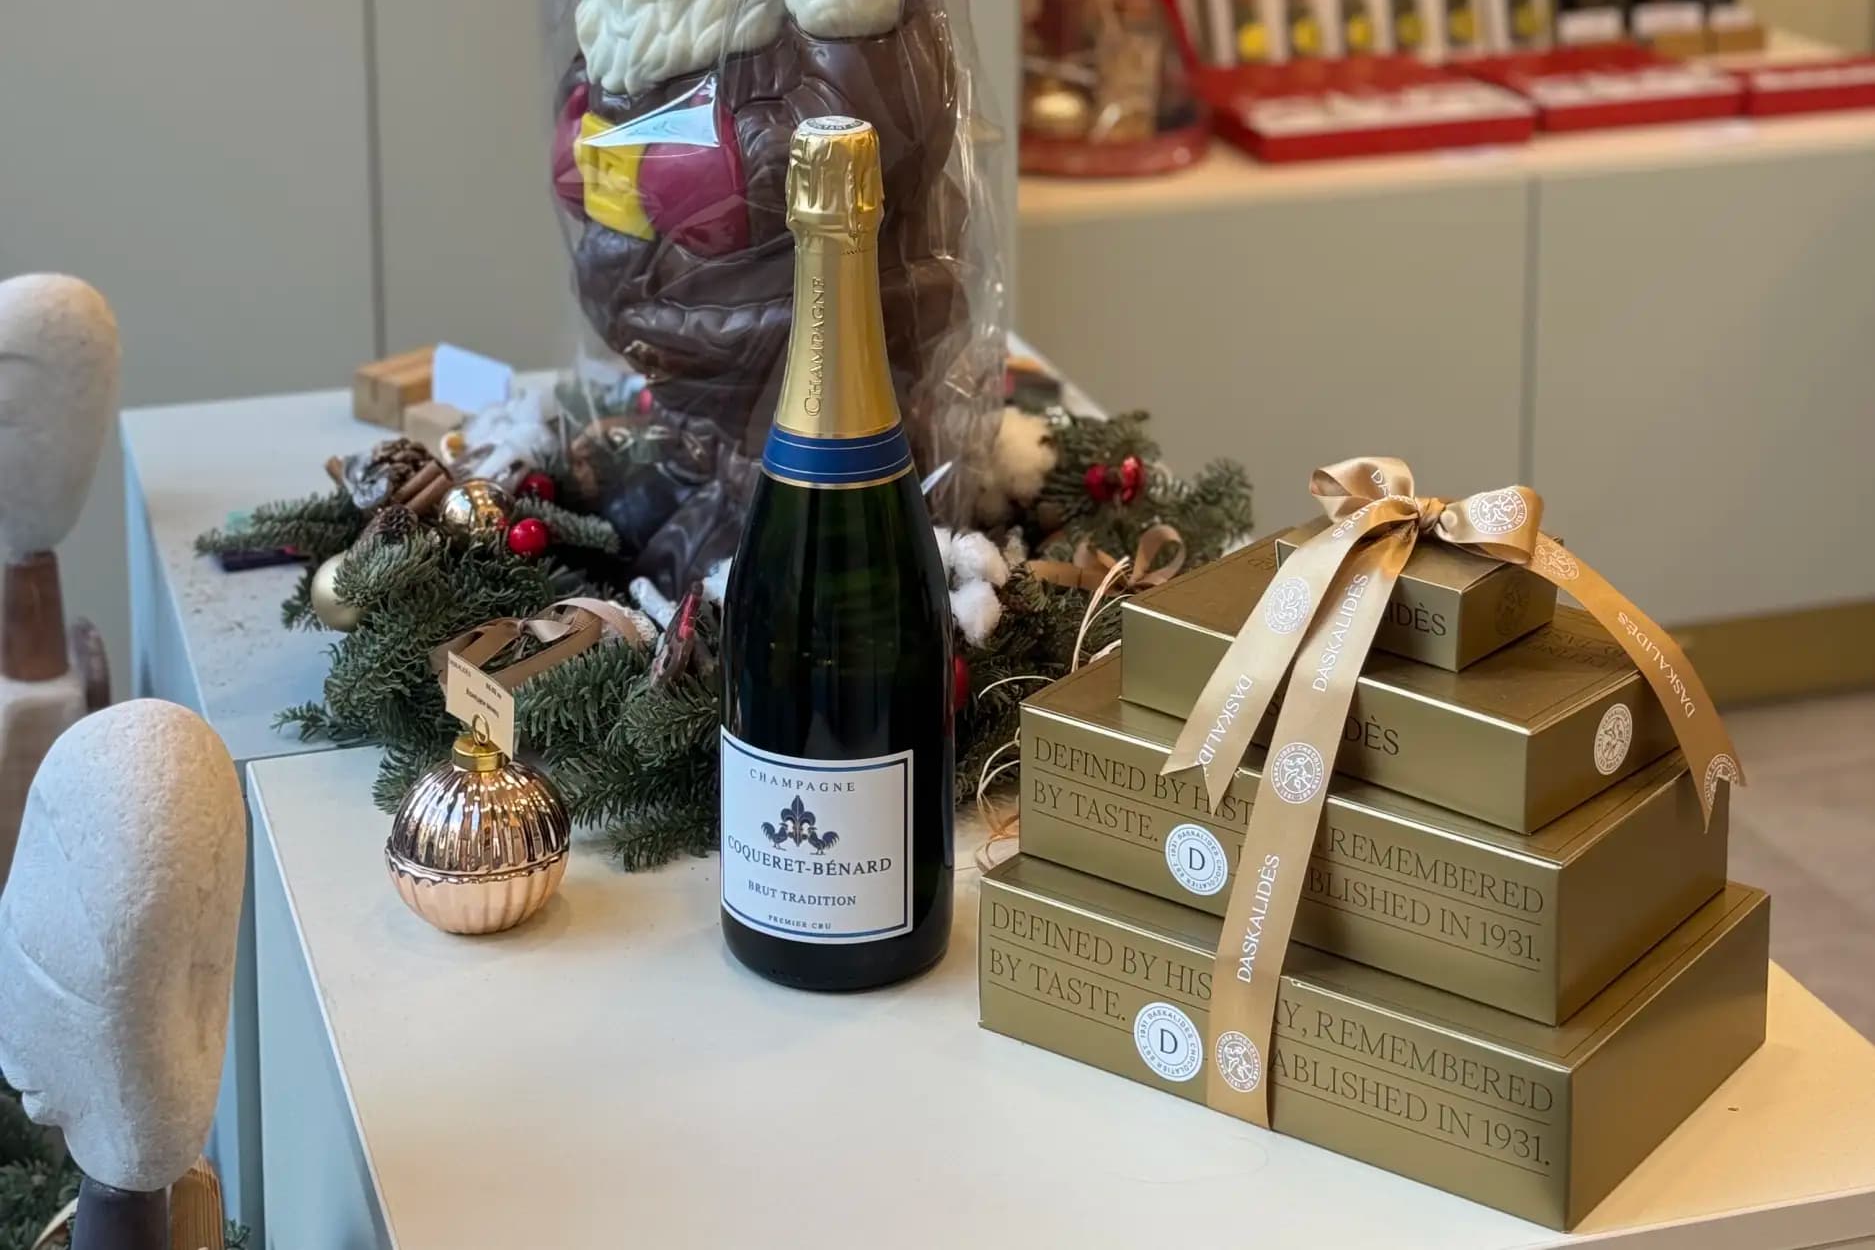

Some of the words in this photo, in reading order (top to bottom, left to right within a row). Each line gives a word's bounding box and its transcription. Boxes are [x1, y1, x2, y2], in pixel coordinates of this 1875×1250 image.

[804, 276, 825, 417] CHAMPAGNE
[1199, 674, 1253, 768] DASKALID
[749, 767, 856, 793] CHAMPAGNE
[1034, 737, 1146, 793] DEFINED
[1153, 774, 1186, 804] BY
[1328, 827, 1544, 914] REMEMBERED
[727, 834, 892, 877] COQUERET-BÉNARD
[748, 879, 778, 900] BRUT
[780, 890, 857, 907] TRADITION
[1033, 779, 1063, 810] BY
[1069, 792, 1159, 843] TASTE.
[1439, 906, 1472, 940] IN
[1480, 920, 1542, 963] 1931.
[1189, 846, 1206, 872] D
[767, 915, 807, 929] PREMIER
[811, 922, 832, 931] CRU
[1236, 854, 1281, 983] DASKALIDÈS
[990, 901, 1113, 966] DEFINED
[1121, 945, 1158, 981] BY
[1313, 1010, 1553, 1112] REMEMBERED
[1160, 1028, 1178, 1054] D
[990, 948, 1023, 983] BY
[1028, 963, 1126, 1022] TASTE.
[1436, 1103, 1473, 1140] IN
[1481, 1118, 1551, 1167] 1931.
